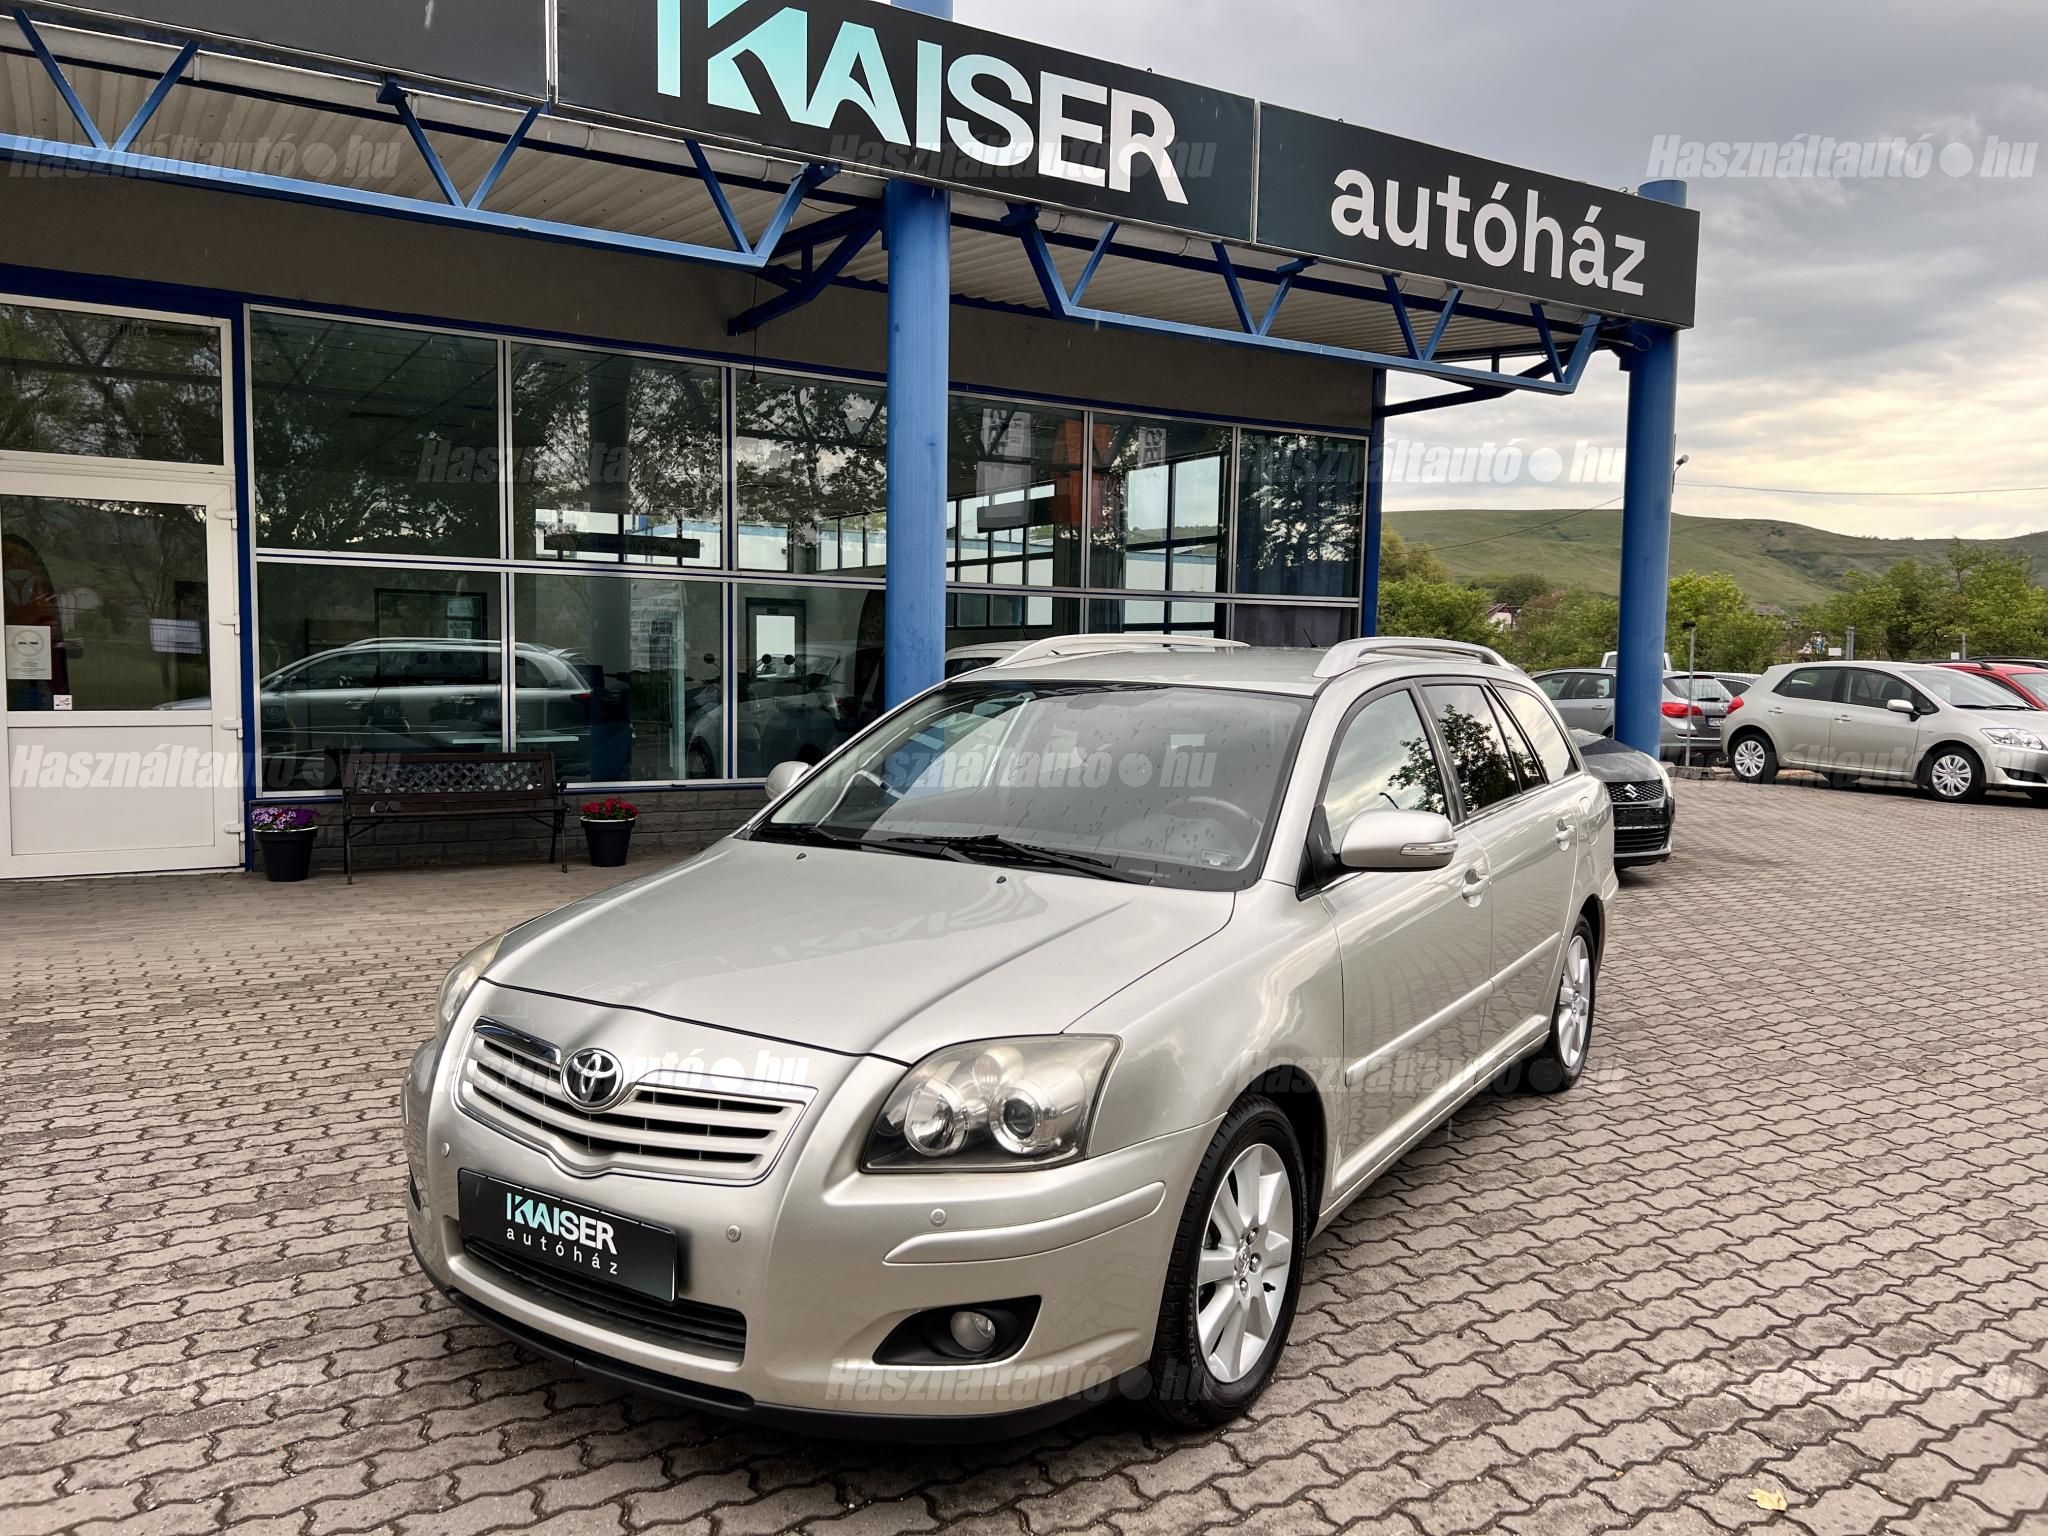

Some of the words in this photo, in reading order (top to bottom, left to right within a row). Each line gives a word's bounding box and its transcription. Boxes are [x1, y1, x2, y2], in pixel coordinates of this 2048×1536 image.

[657, 0, 1189, 205] KAISER
[1330, 168, 1646, 297] autóház
[506, 1192, 618, 1255] KAISER
[506, 1227, 618, 1275] autóház
